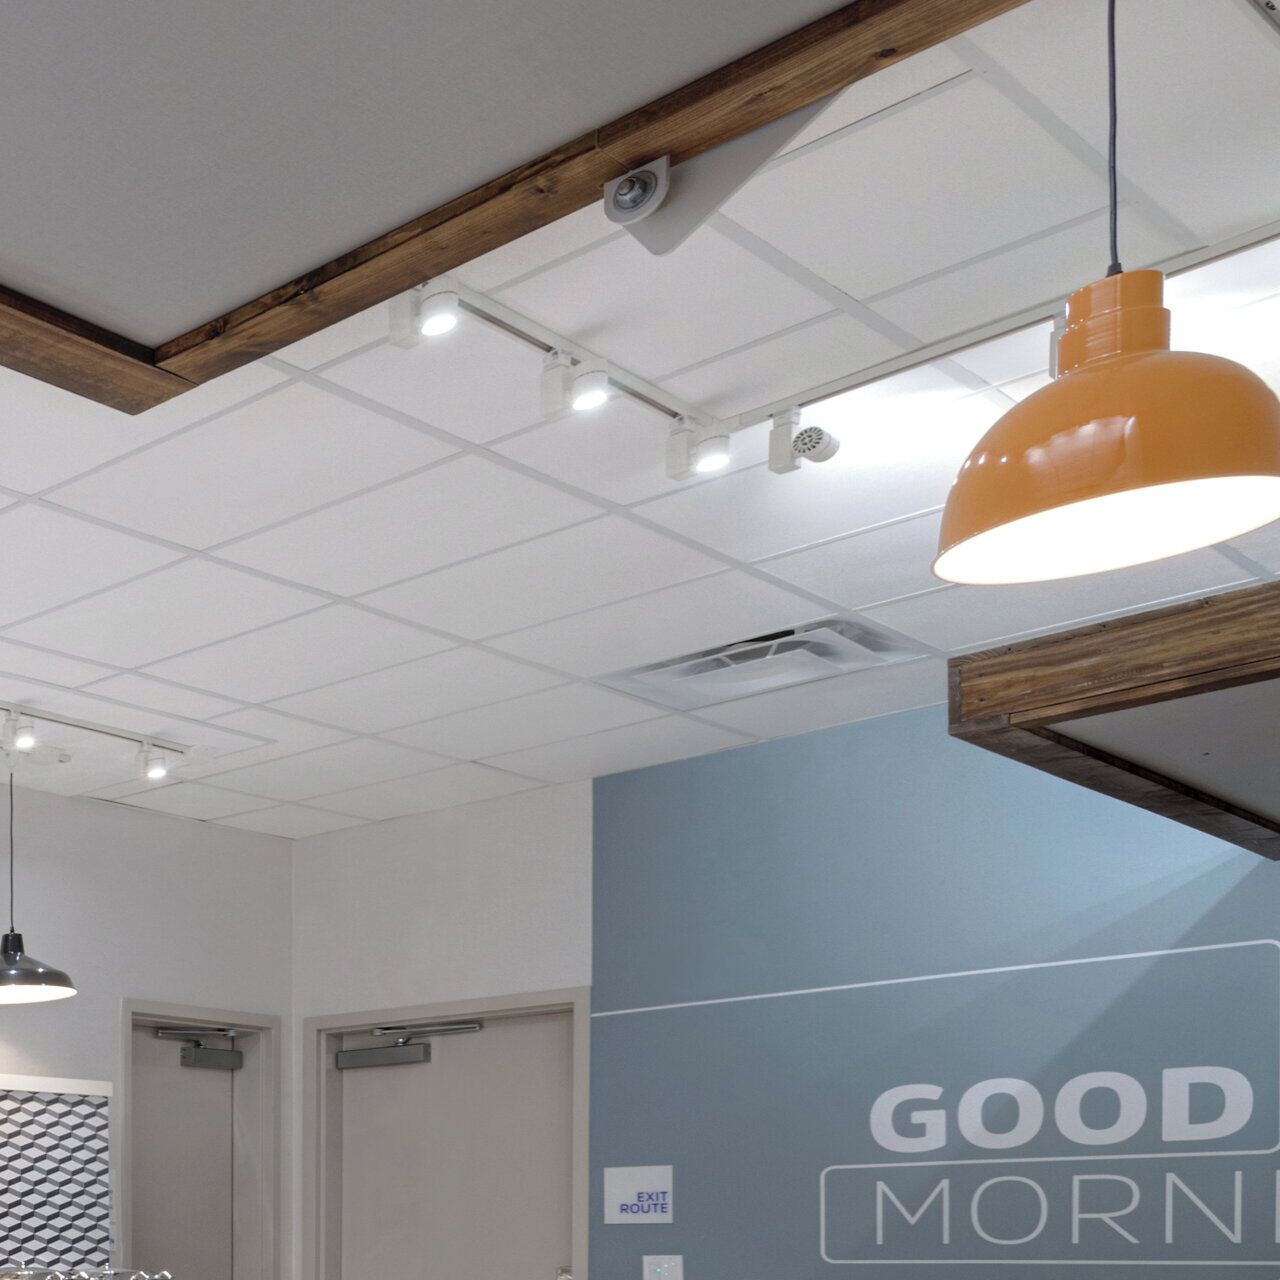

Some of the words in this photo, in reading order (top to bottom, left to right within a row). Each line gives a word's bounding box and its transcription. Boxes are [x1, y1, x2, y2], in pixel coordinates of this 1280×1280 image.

[869, 1065, 1254, 1153] GOOD
[637, 1191, 669, 1202] EXIT
[620, 1202, 669, 1214] ROUTE
